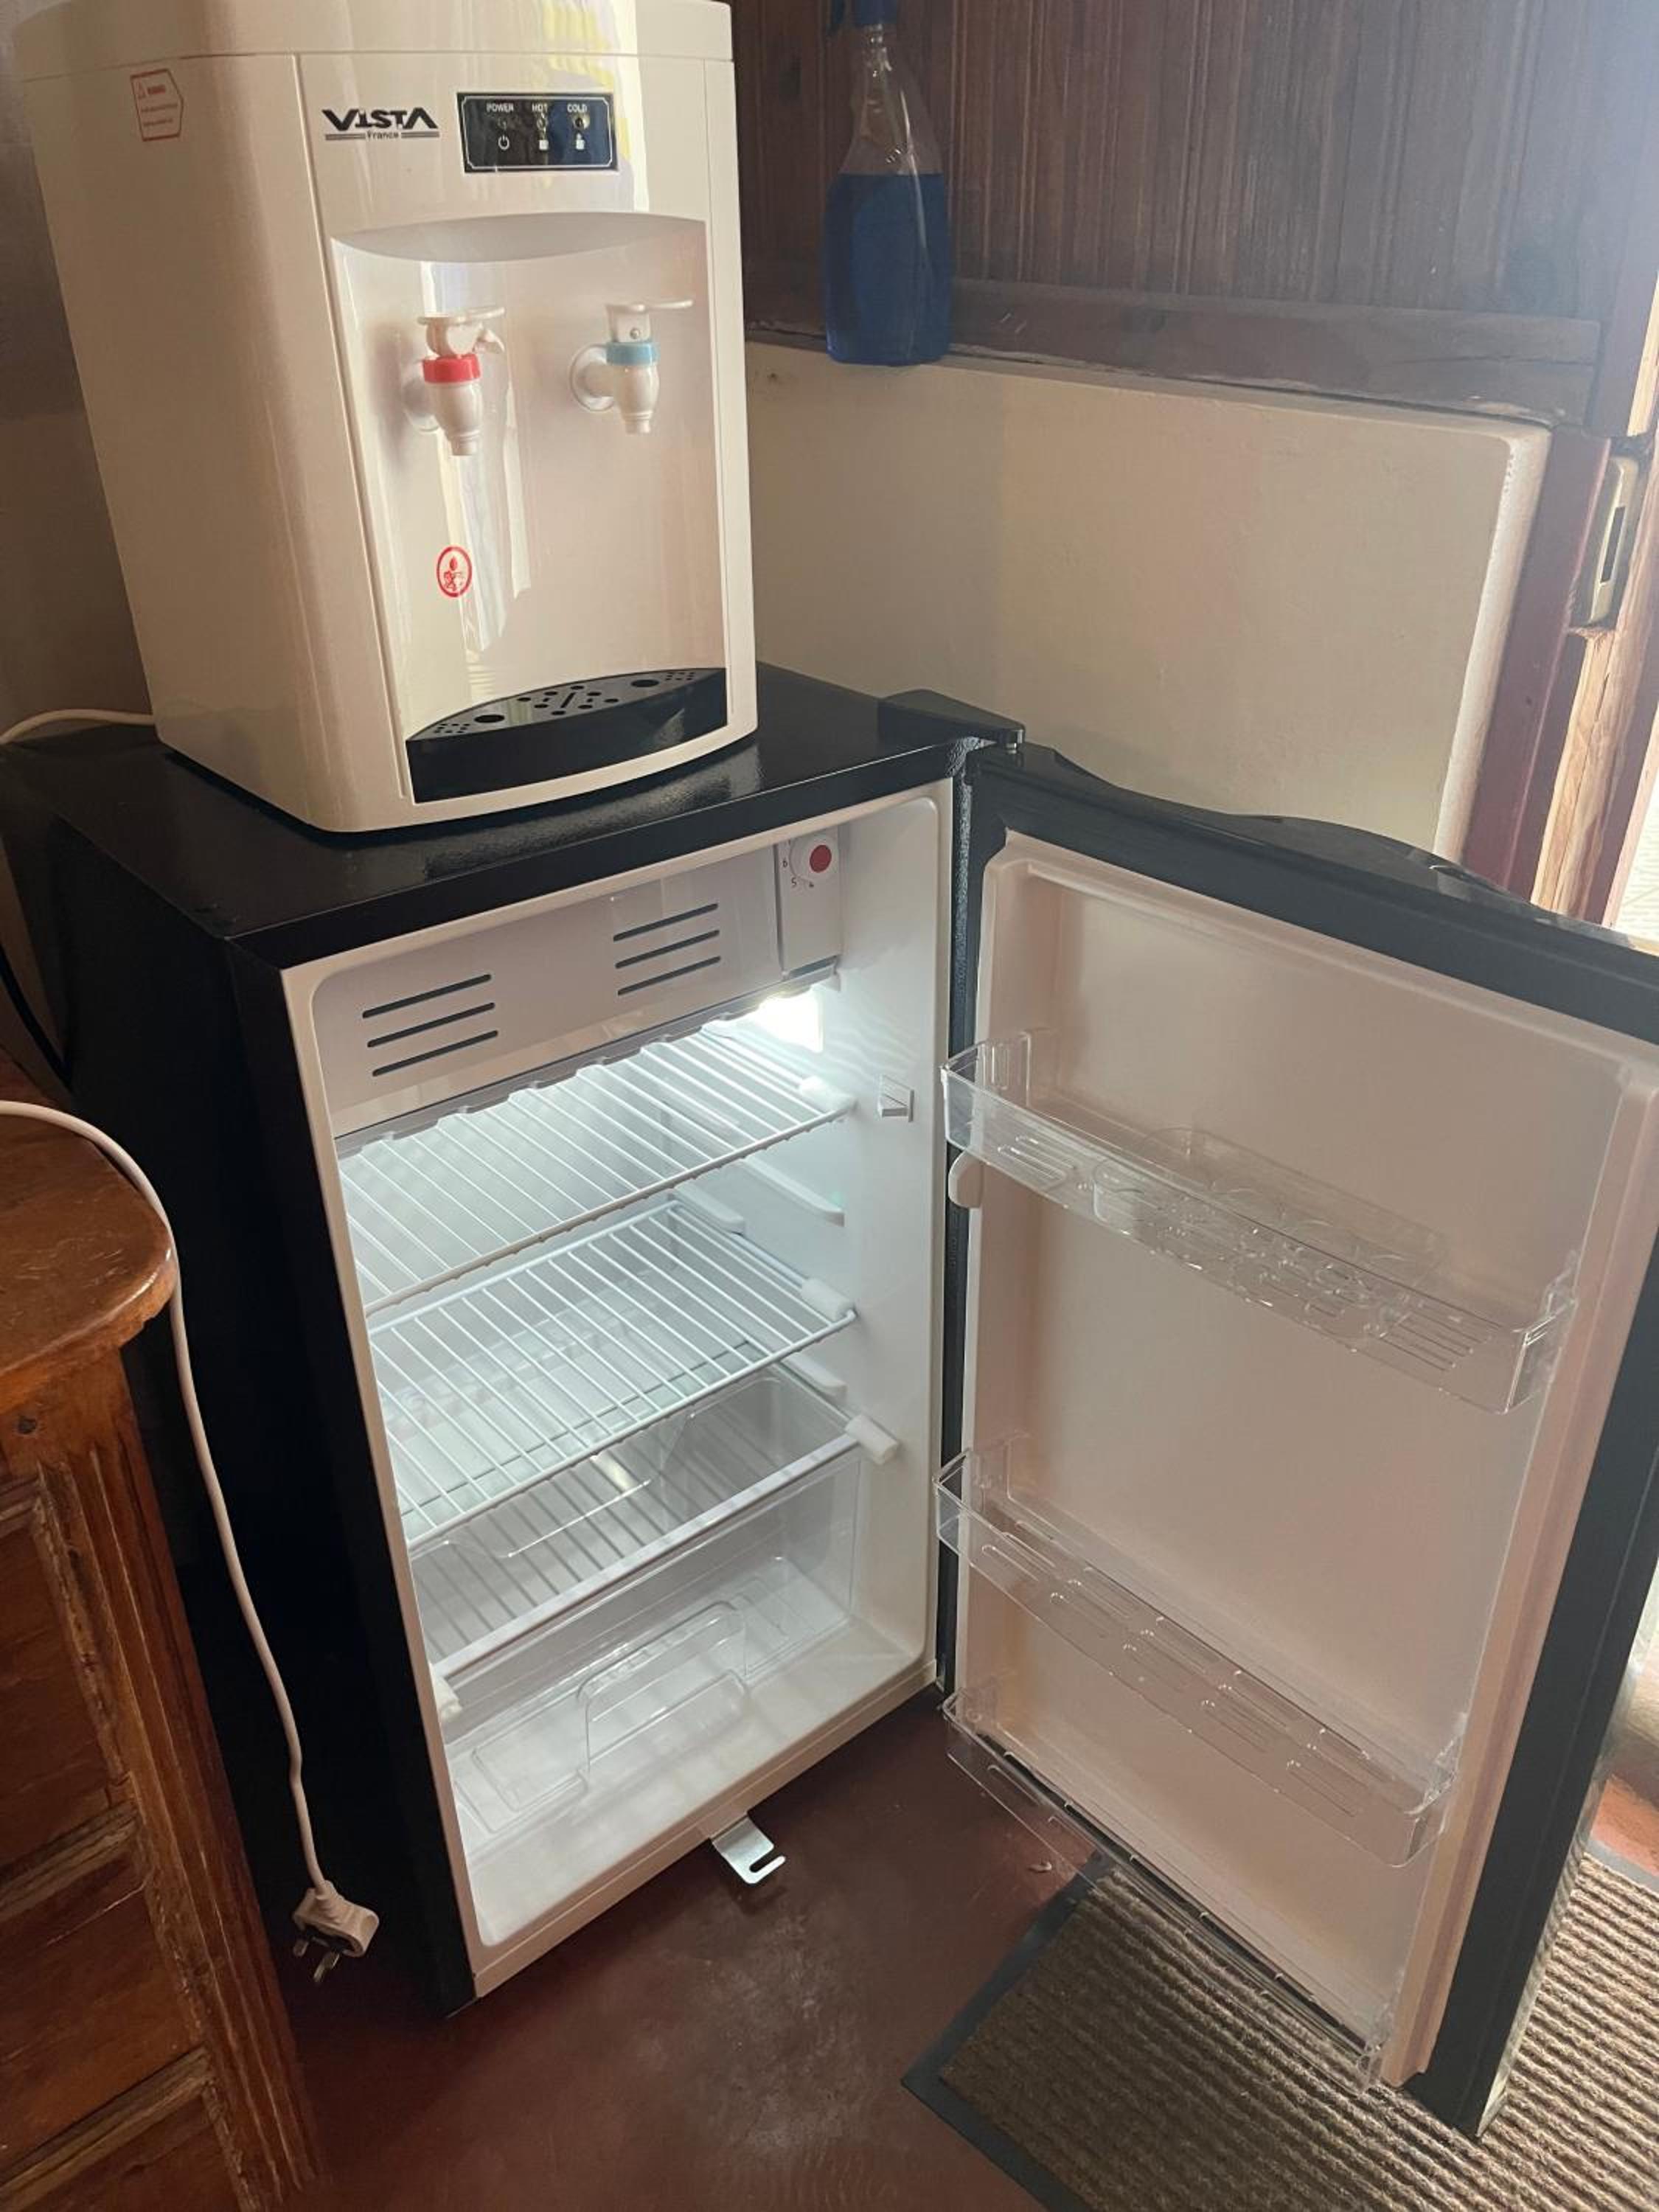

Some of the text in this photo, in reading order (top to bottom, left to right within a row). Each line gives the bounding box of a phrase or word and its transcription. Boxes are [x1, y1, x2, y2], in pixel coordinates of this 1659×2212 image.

[486, 103, 588, 112] POWER HOT COLD
[367, 131, 399, 140] France
